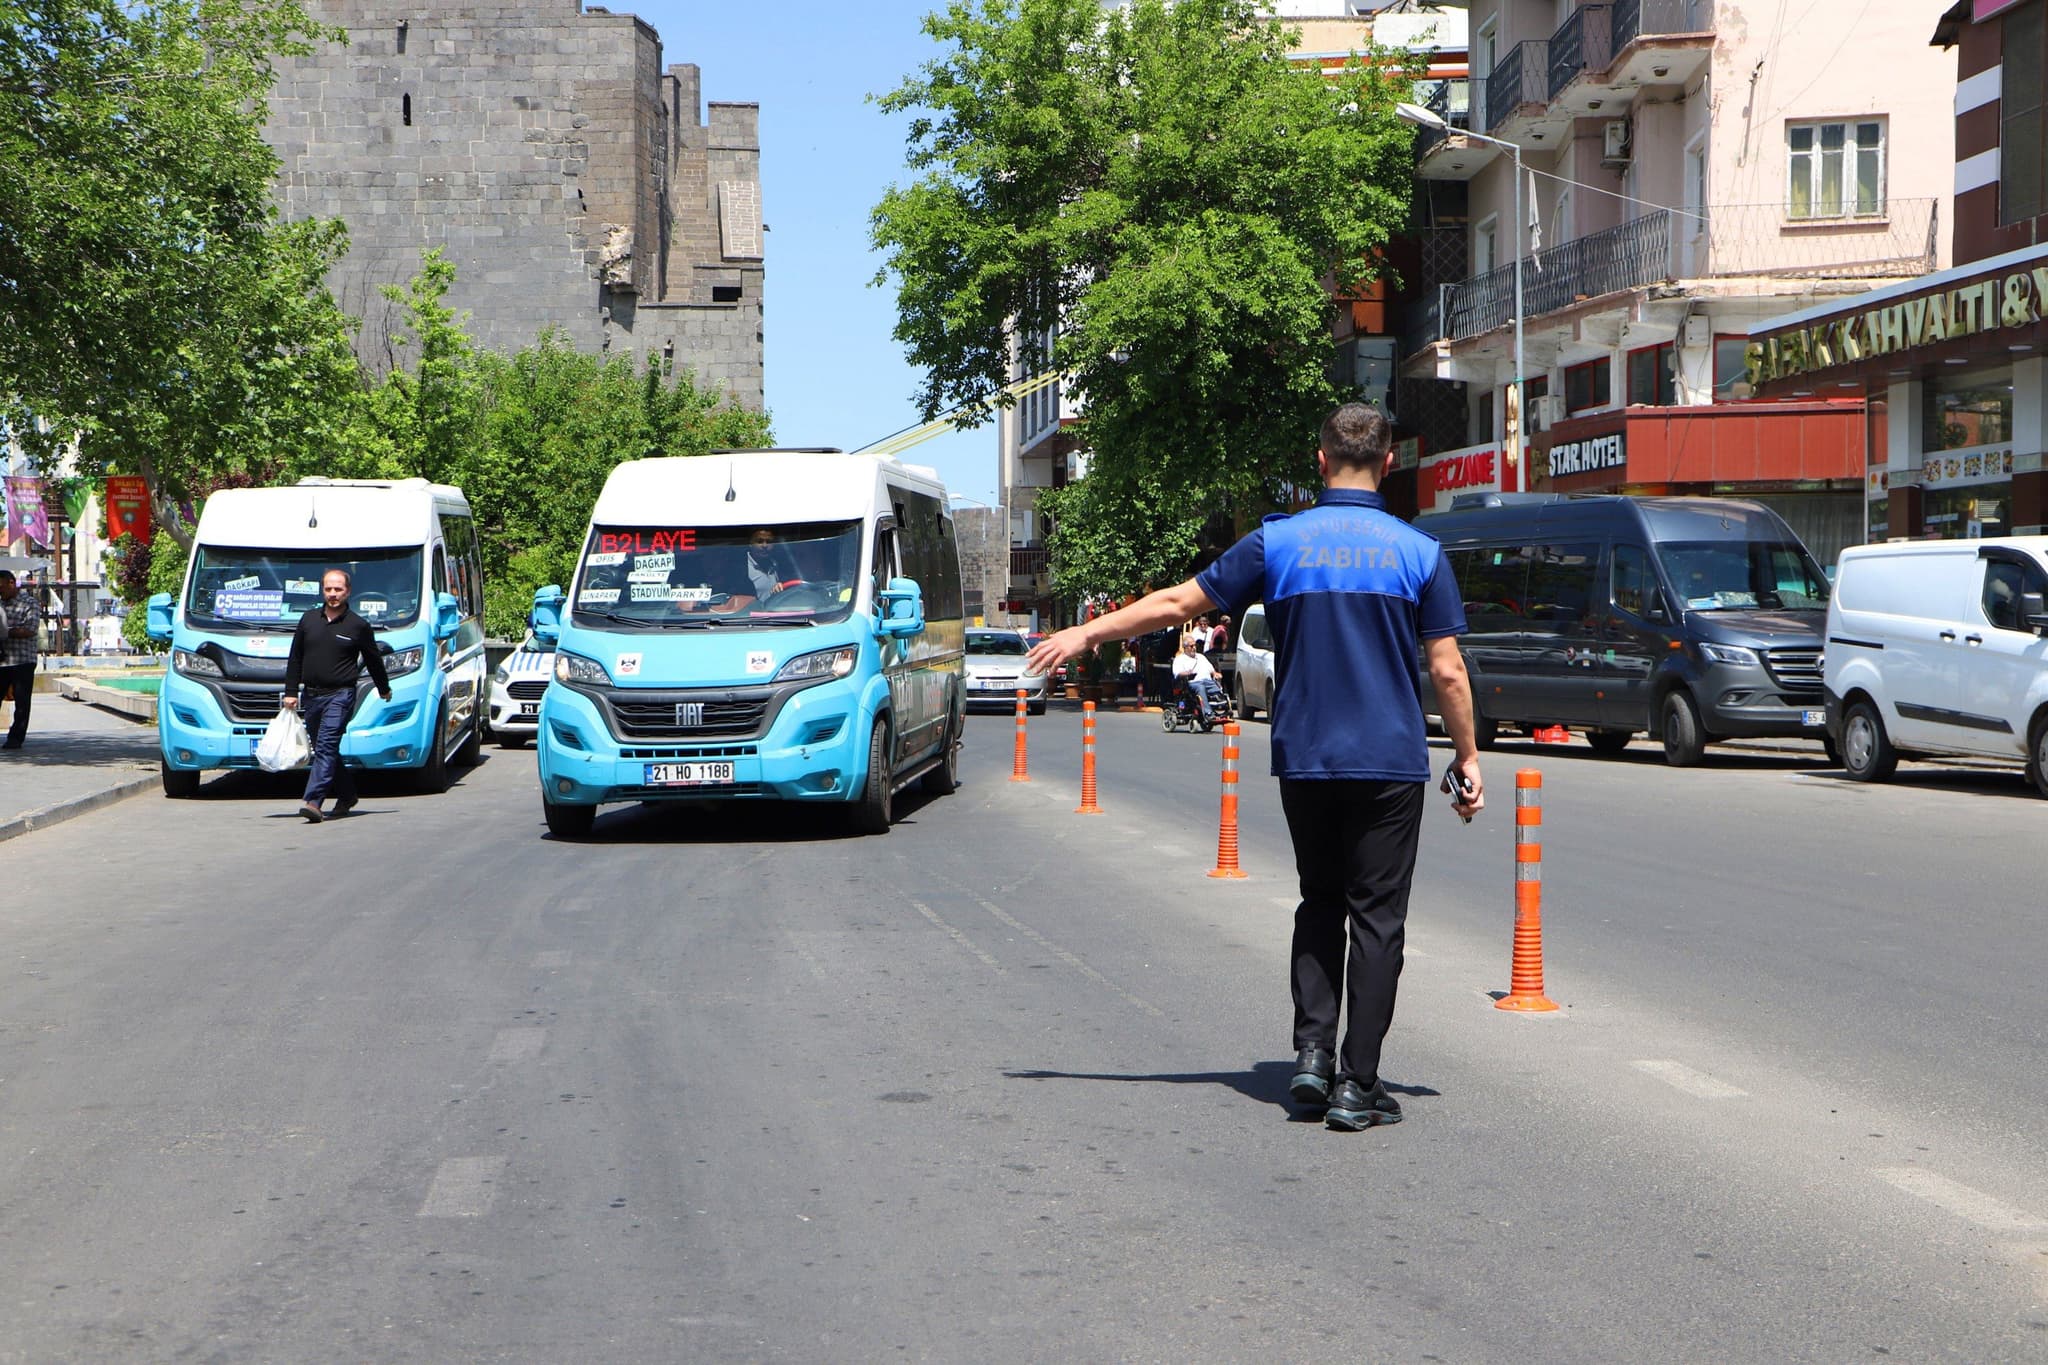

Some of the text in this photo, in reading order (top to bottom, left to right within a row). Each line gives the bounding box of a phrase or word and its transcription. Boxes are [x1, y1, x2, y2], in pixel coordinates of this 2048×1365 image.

[1838, 280, 2000, 362] KAHVALTI
[1549, 434, 1627, 477] STAR HOTEL
[1434, 450, 1496, 492] ECZANE
[1297, 546, 1399, 570] ZABITA
[216, 594, 233, 608] C5
[631, 588, 671, 598] STADYUM
[676, 703, 704, 726] FIAT
[654, 766, 668, 780] 21
[700, 764, 729, 778] 1188
